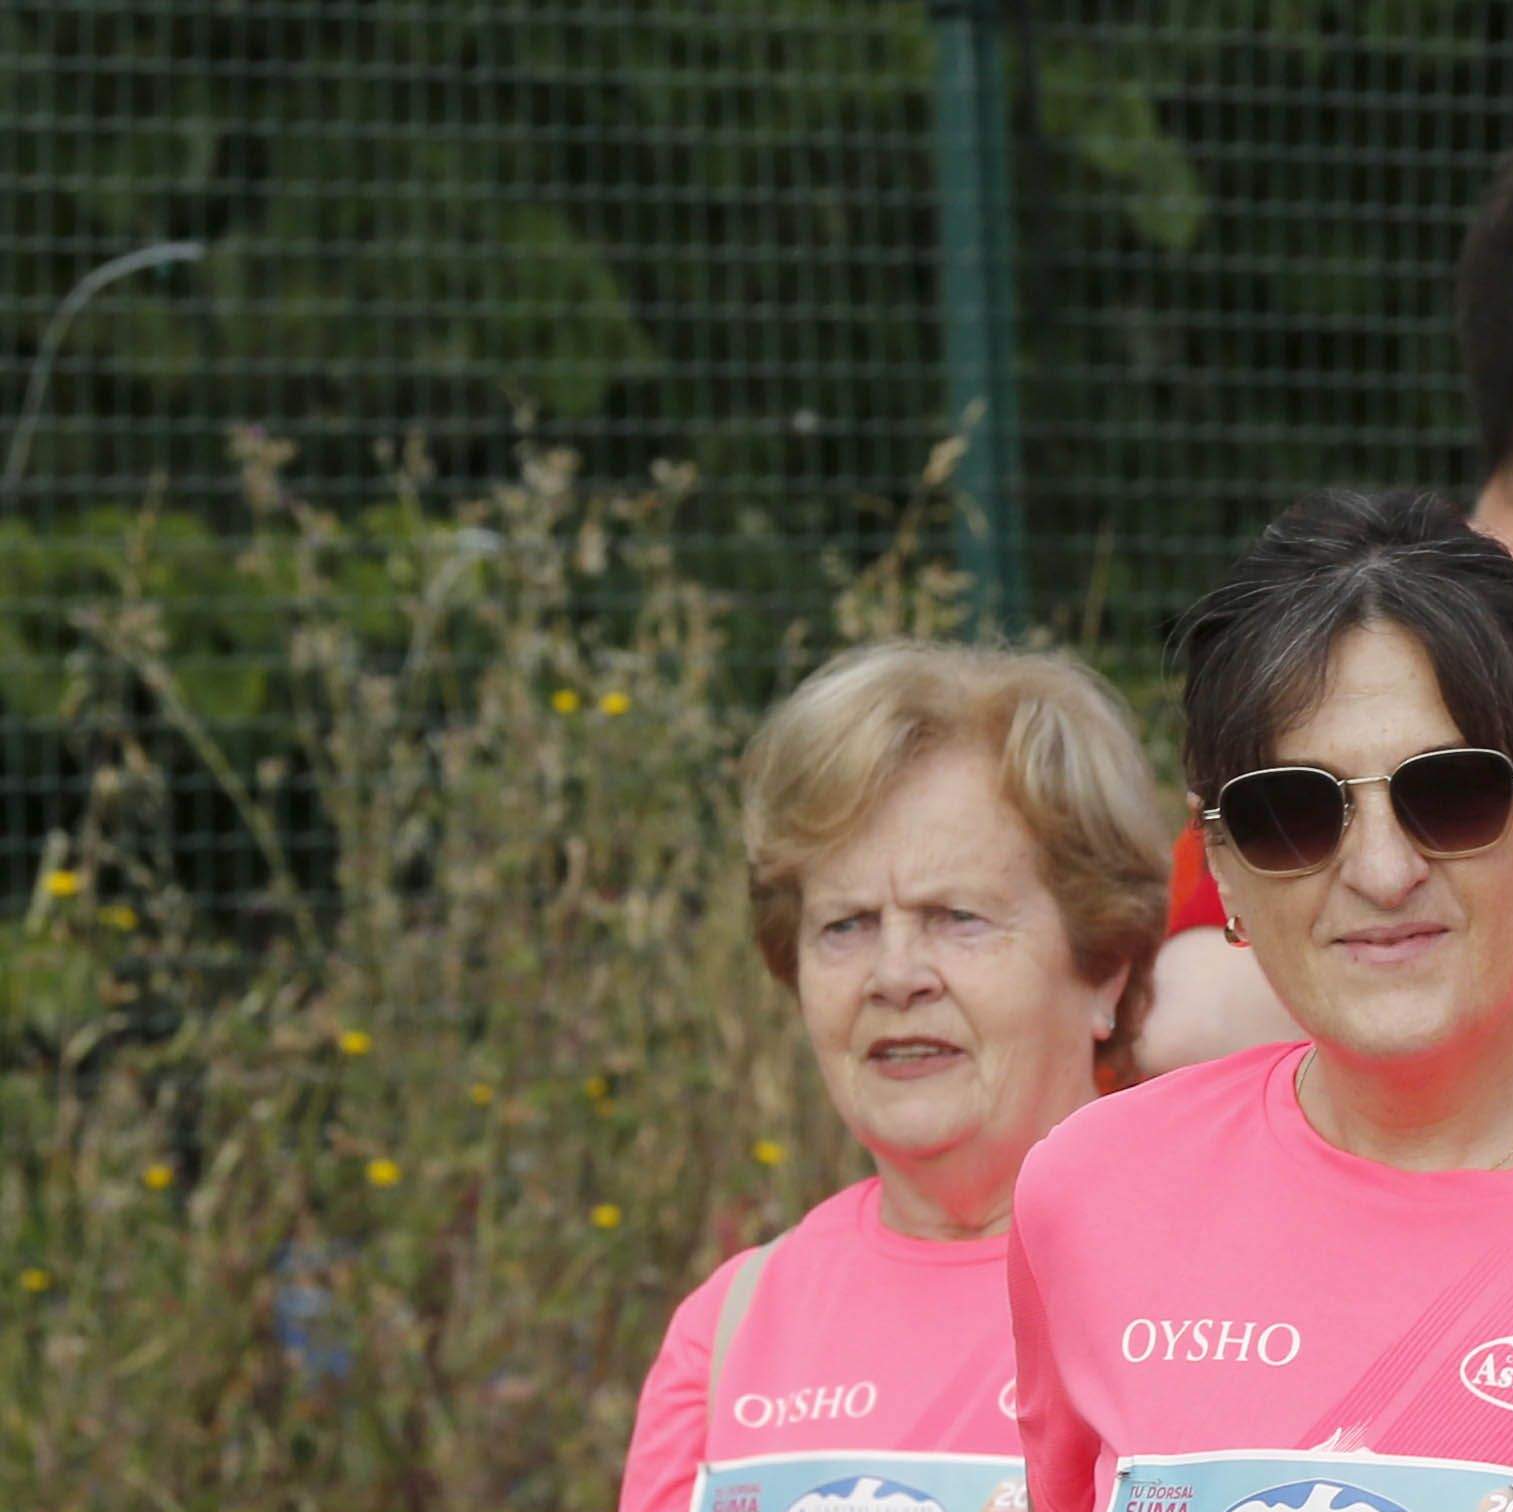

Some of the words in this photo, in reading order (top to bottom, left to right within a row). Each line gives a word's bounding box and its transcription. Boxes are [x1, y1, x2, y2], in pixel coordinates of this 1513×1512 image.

[1120, 1318, 1301, 1367] OYSHO
[733, 1381, 878, 1429] OYSHO
[1130, 1485, 1144, 1498] TU
[1147, 1486, 1194, 1500] DORSAL
